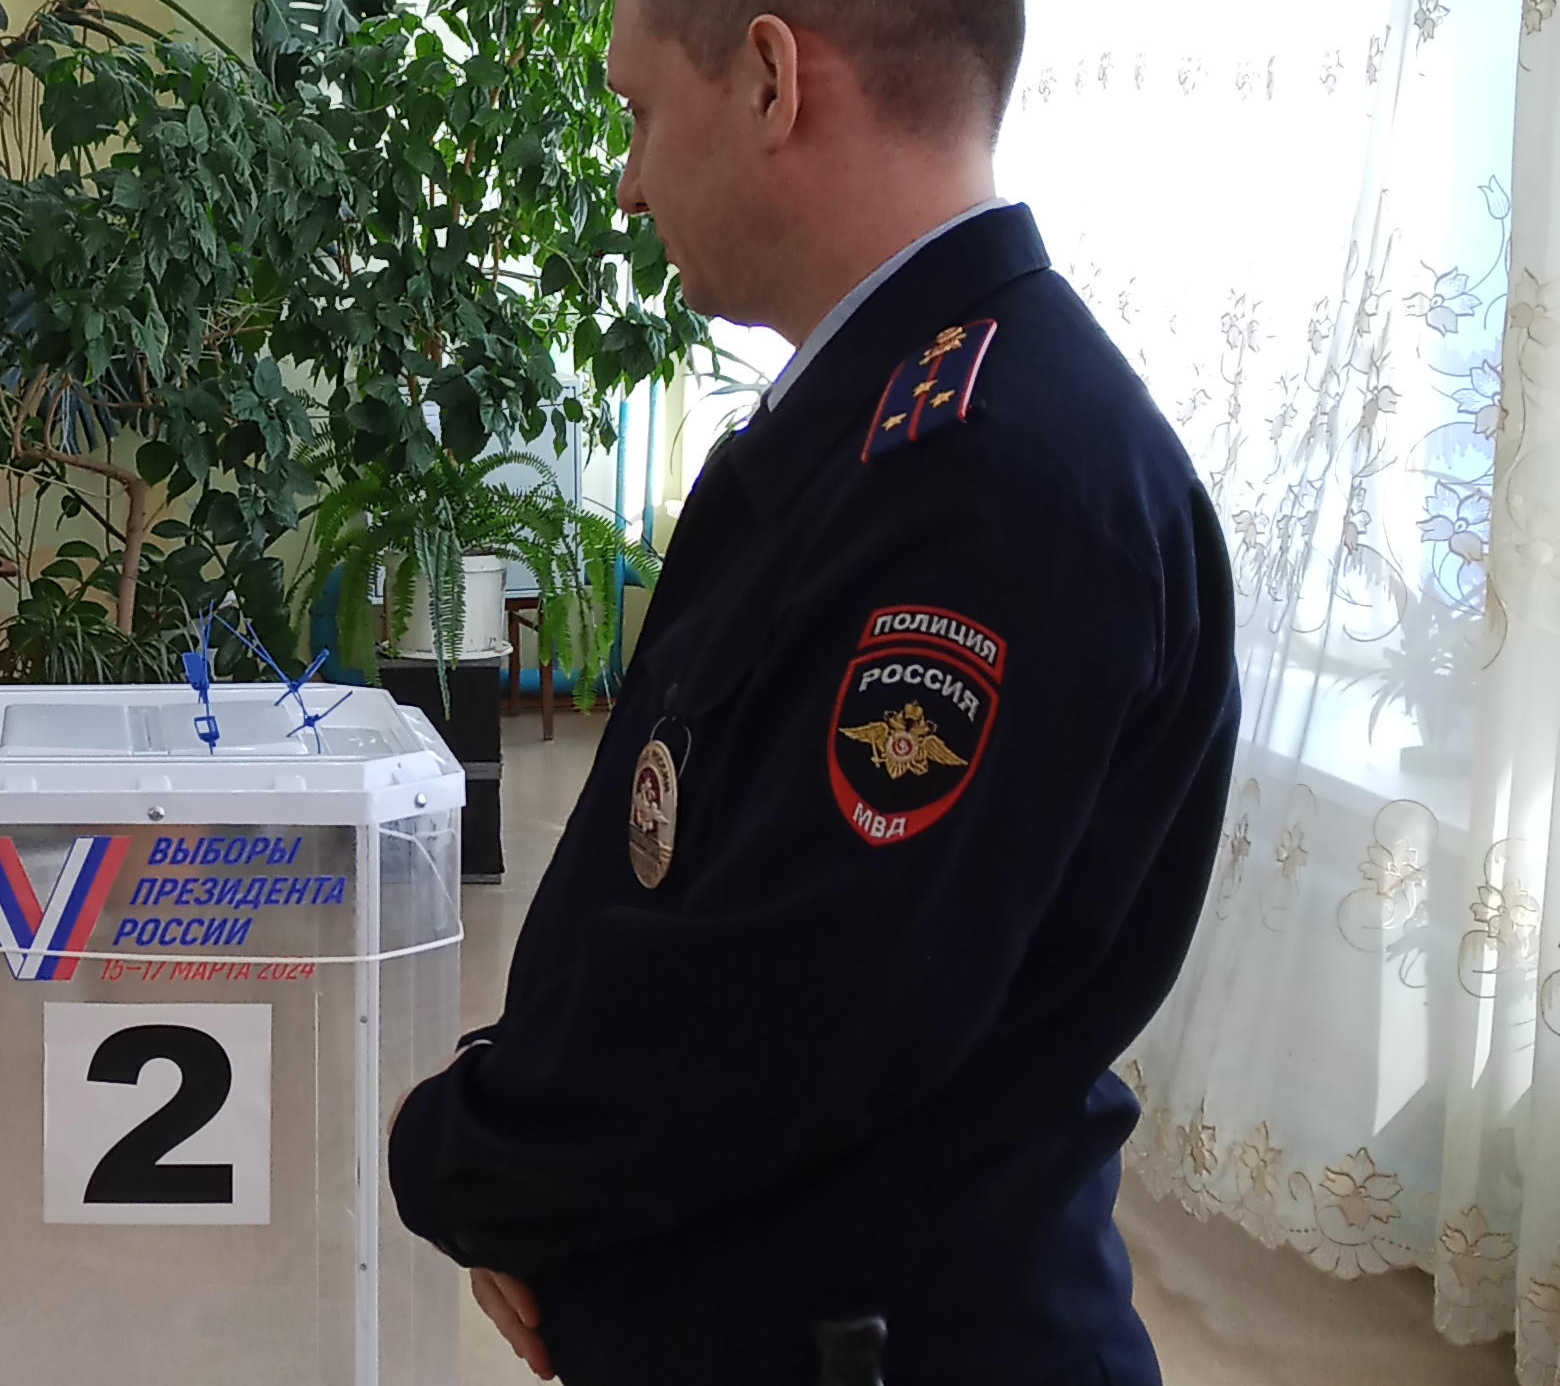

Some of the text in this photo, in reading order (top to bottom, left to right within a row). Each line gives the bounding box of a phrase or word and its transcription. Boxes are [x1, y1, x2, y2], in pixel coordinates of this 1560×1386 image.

[874, 613, 997, 664] ПОЛИЦИЯ
[858, 663, 979, 722] РОССИЯ
[852, 802, 907, 839] МВД
[148, 836, 303, 866] ВЫБОРЫ
[130, 875, 347, 910] ПРЕЗИДЕНТА
[113, 917, 254, 947] РОССИИ
[83, 1024, 233, 1204] 2
